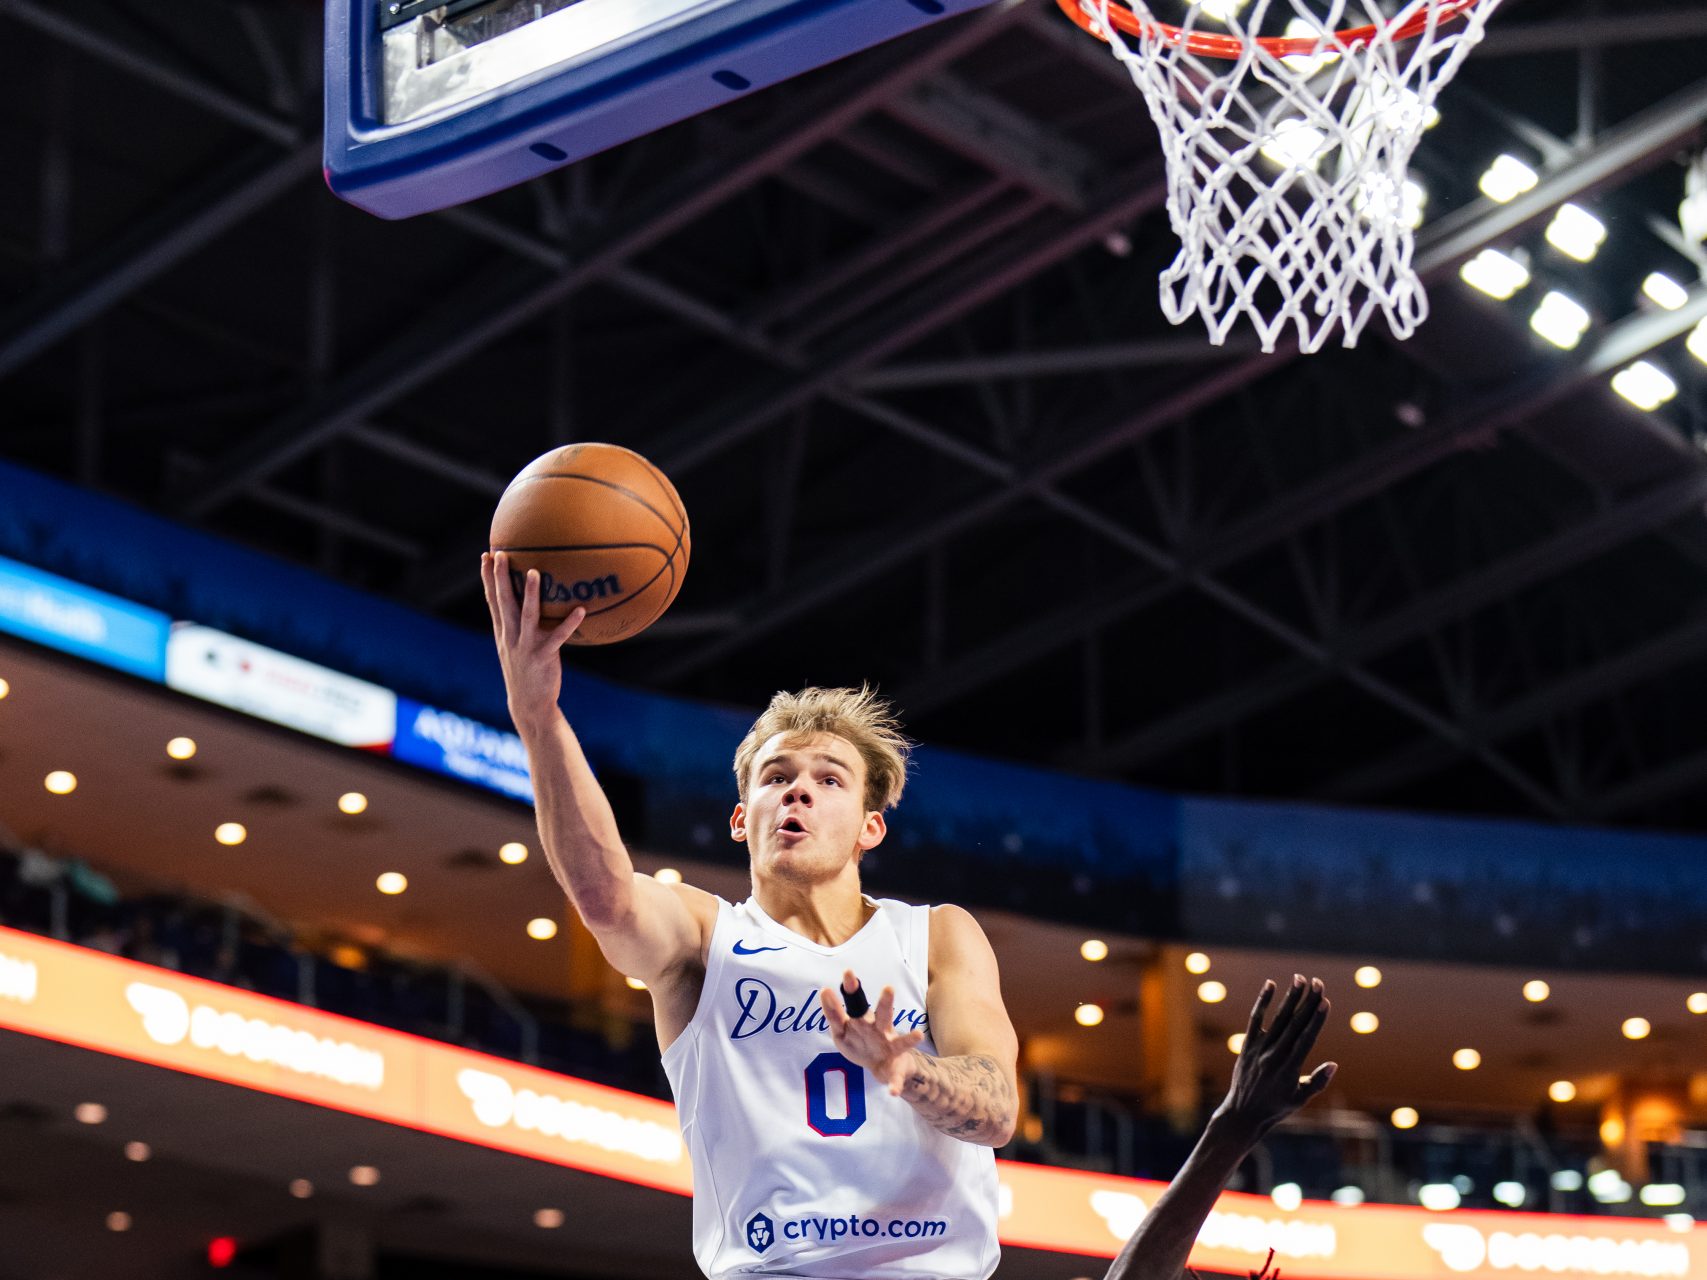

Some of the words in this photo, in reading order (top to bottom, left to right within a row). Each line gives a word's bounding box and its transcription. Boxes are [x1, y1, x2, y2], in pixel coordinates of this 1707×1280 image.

[731, 977, 929, 1040] Delare
[804, 1052, 867, 1138] 0
[783, 1214, 947, 1241] crypto.com
